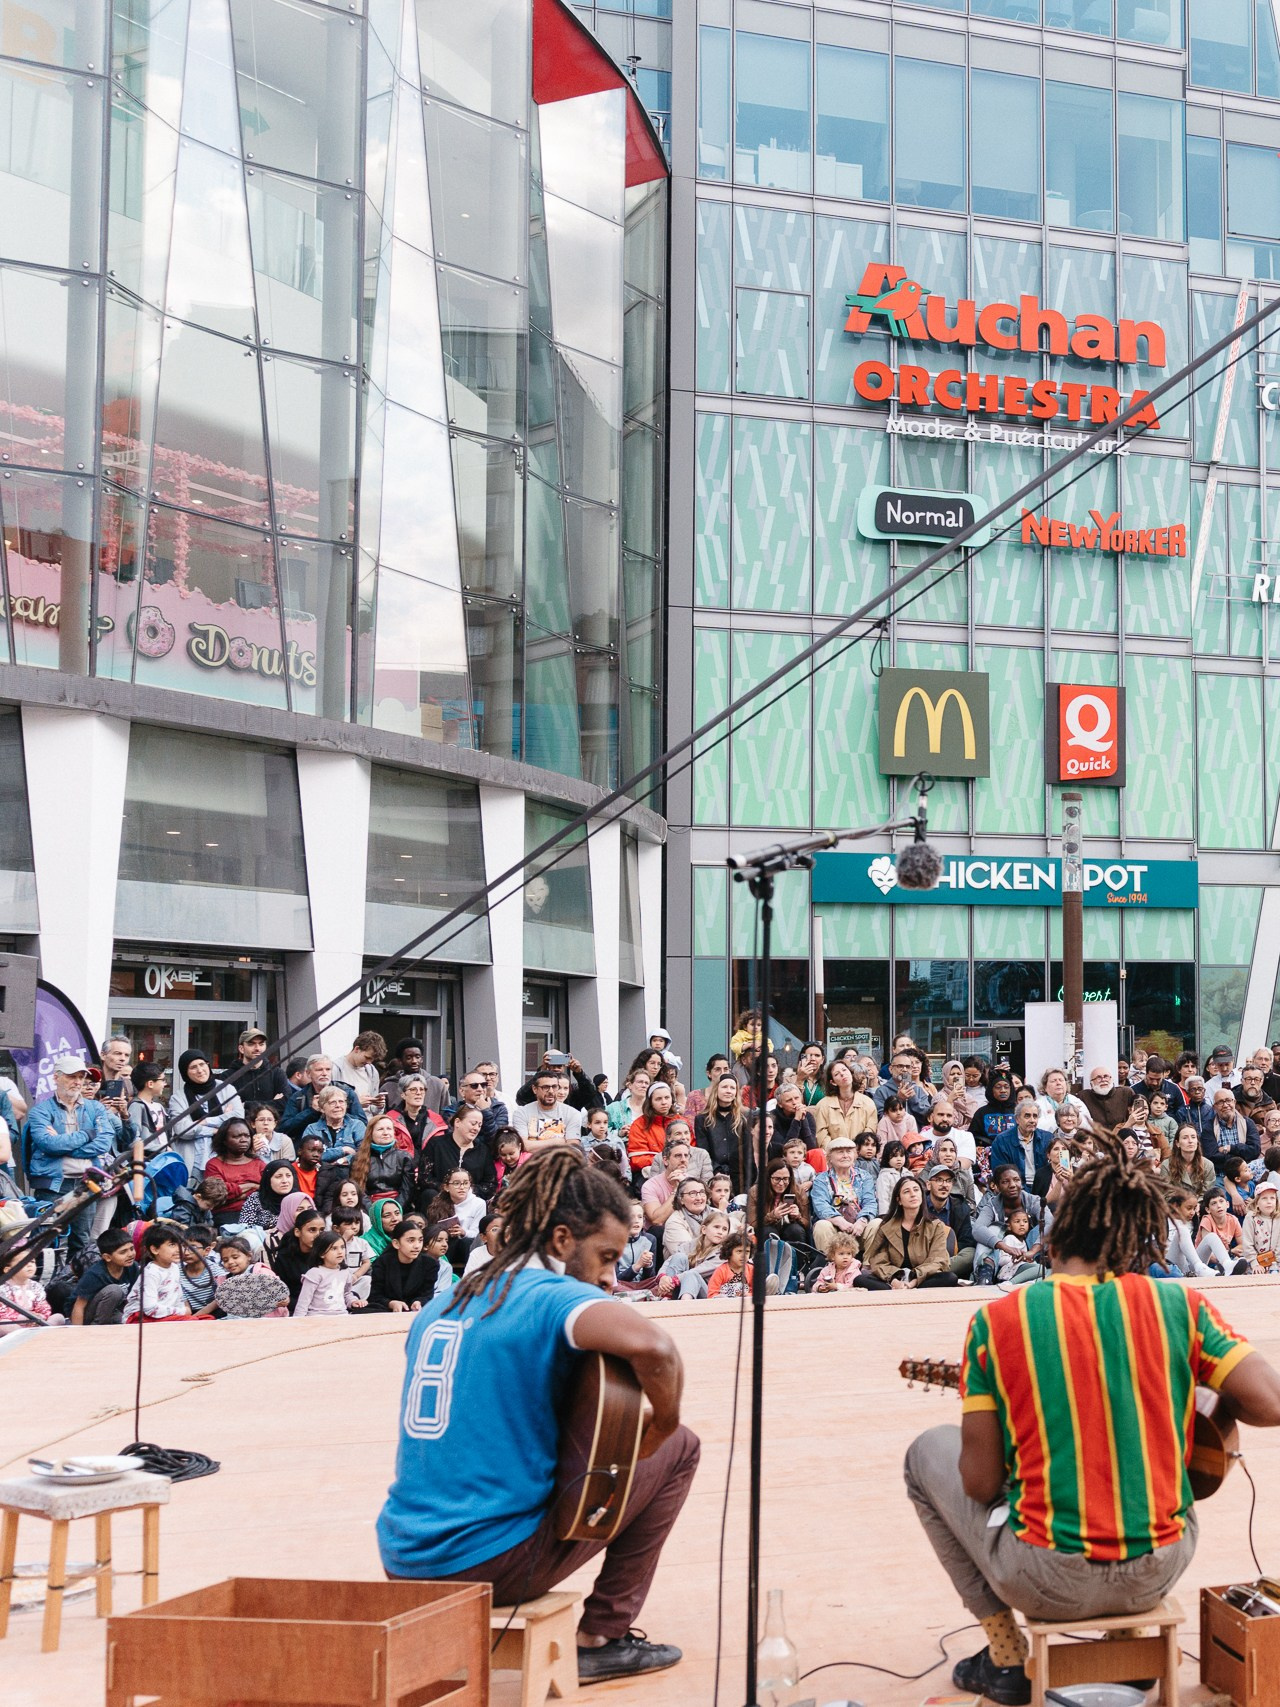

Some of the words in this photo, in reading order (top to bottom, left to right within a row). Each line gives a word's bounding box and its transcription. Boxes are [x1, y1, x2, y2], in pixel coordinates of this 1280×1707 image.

[844, 262, 1166, 367] Auchan
[854, 361, 1160, 430] ORCHESTRA
[886, 415, 957, 439] Mode
[965, 421, 982, 441] &
[886, 499, 963, 528] Normal
[1066, 755, 1111, 775] Quick
[934, 861, 1056, 891] HICKEN
[1083, 864, 1148, 892] POT
[45, 1036, 72, 1055] LA
[38, 1048, 87, 1075] CUT
